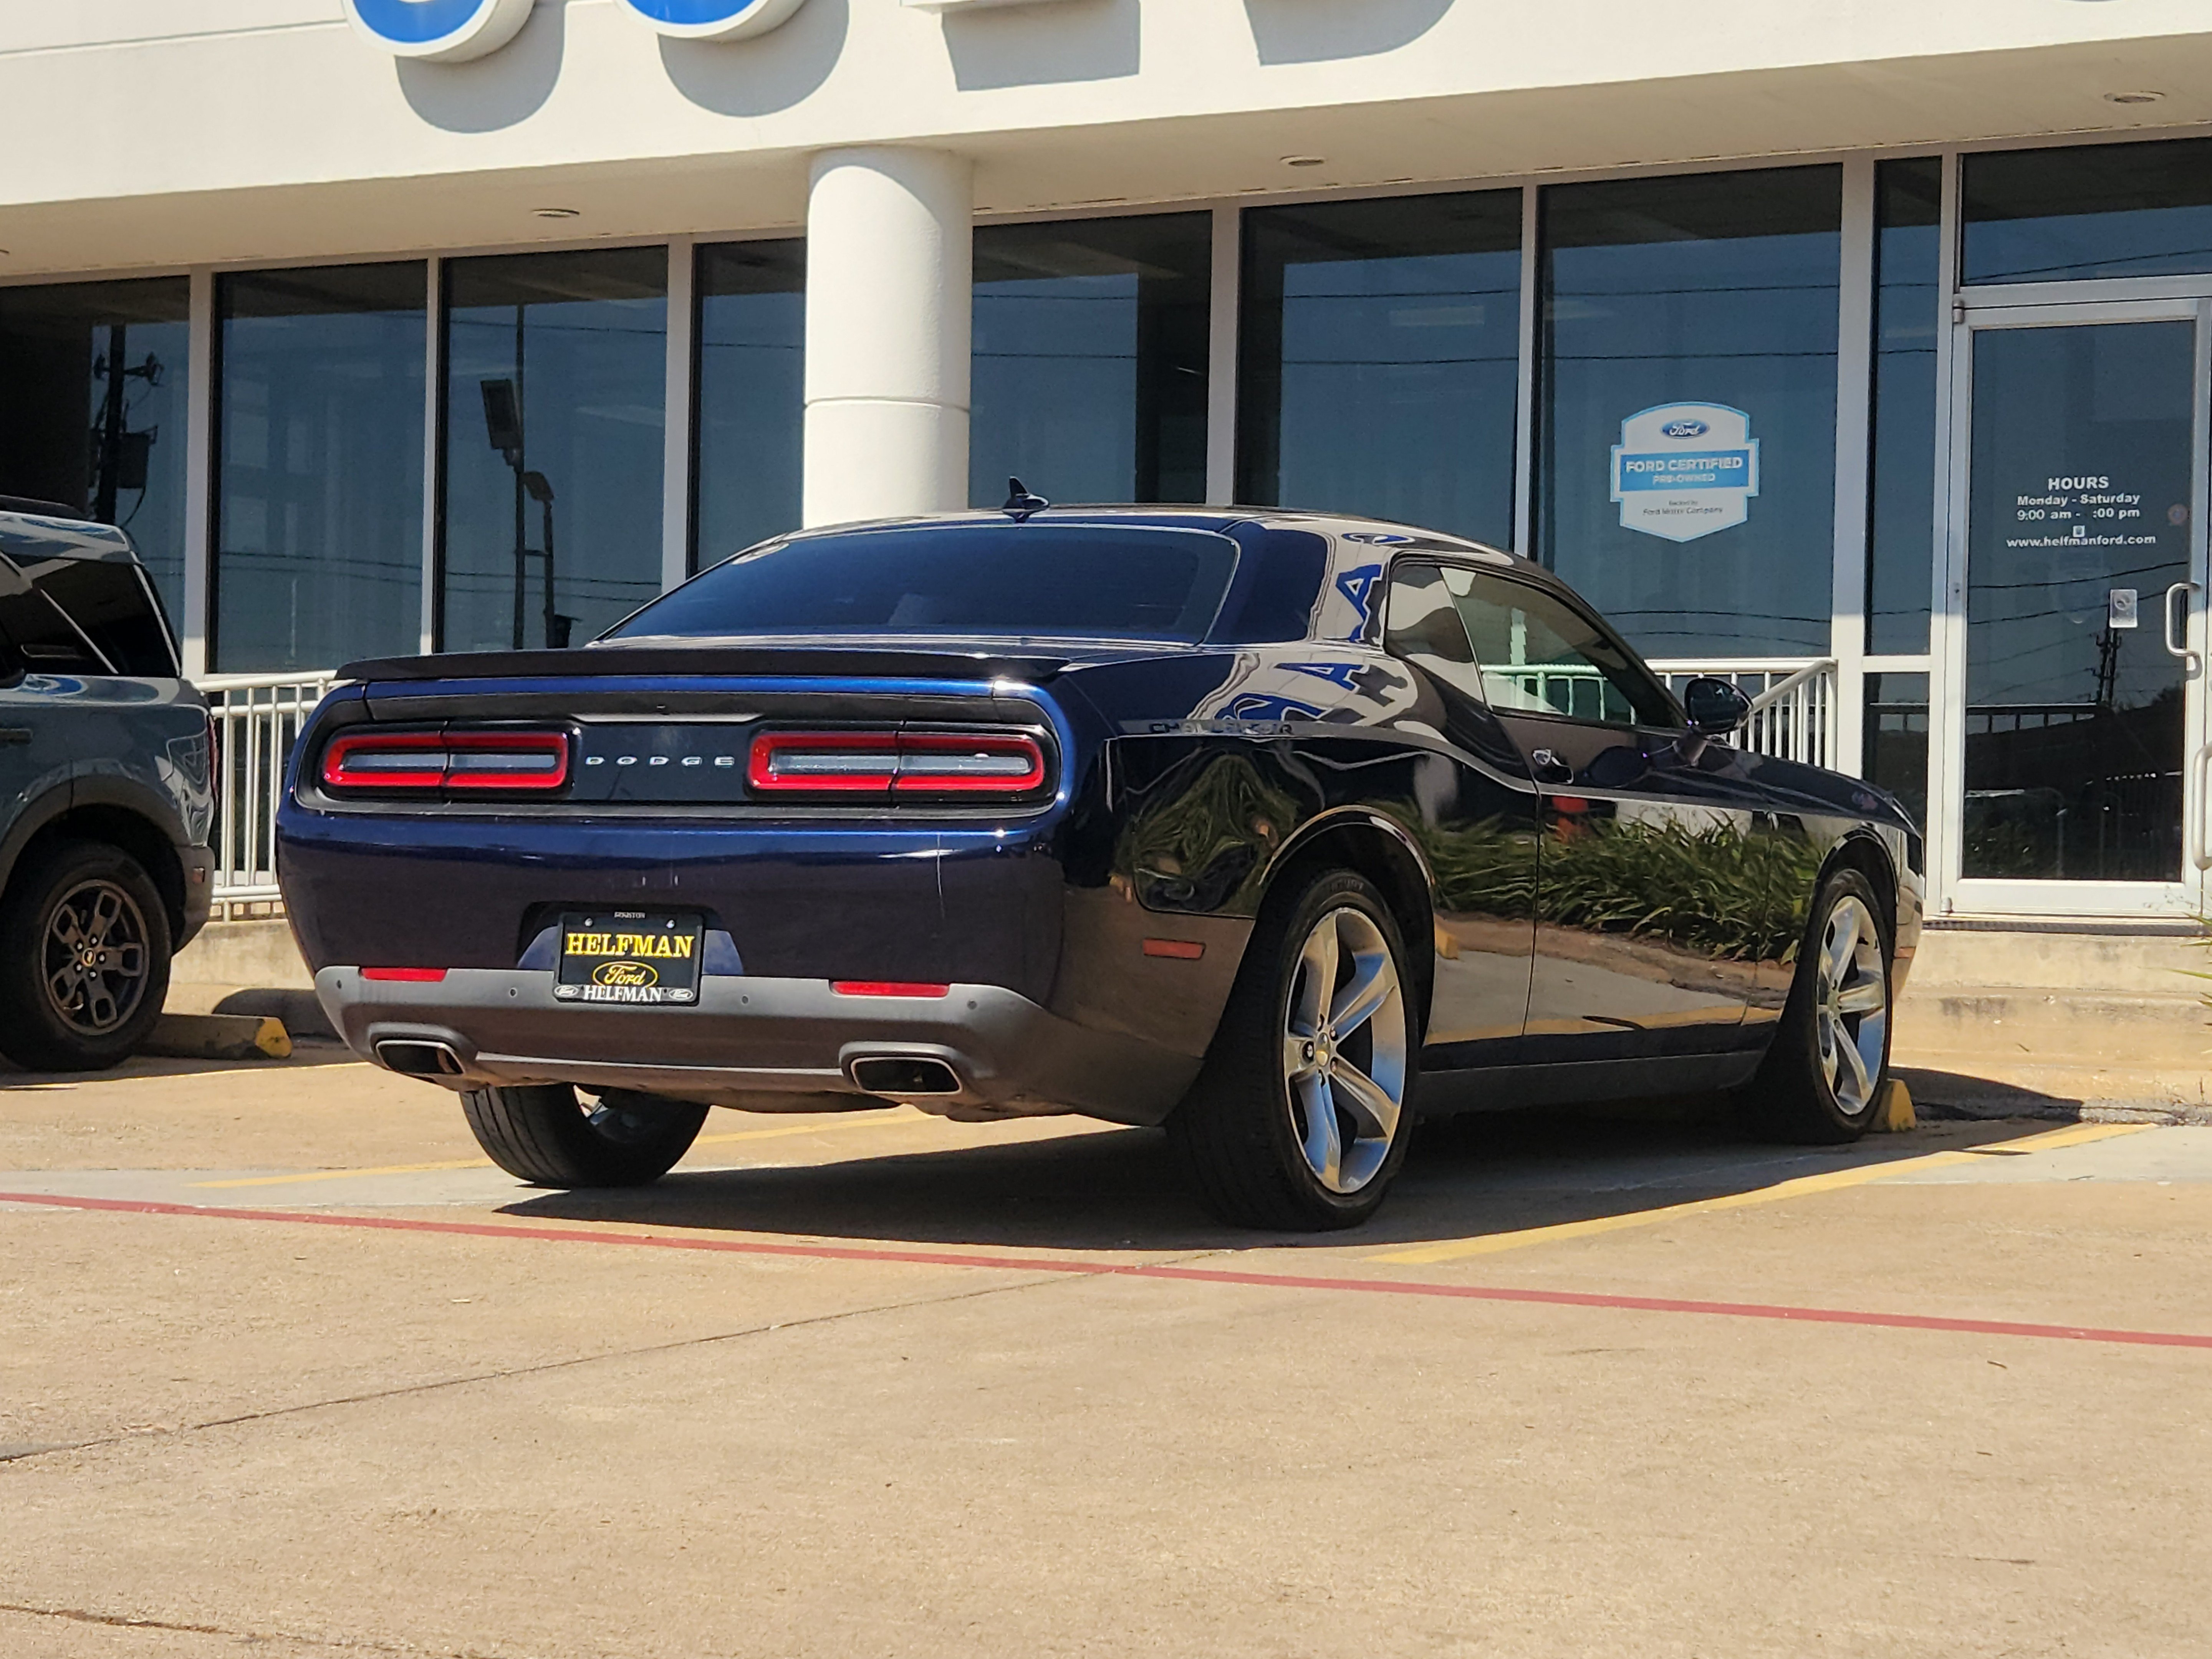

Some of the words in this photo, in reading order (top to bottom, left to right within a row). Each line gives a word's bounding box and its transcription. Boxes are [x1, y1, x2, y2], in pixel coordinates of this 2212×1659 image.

[1669, 422, 1700, 435] Ford
[1626, 460, 1664, 473] FORD
[1668, 457, 1743, 471] CERTIFIED
[1653, 473, 1715, 485] PRE-OWNED
[2048, 476, 2109, 492] HOURS
[2017, 495, 2068, 507] Monday
[2080, 493, 2140, 505] Saturday
[2017, 509, 2045, 521] 9:00
[2050, 511, 2072, 520] am
[2118, 508, 2140, 520] pm
[2006, 534, 2156, 548] www.helfmanford.com
[1149, 722, 1295, 734] CHALLER
[585, 756, 735, 767] DODGE
[565, 933, 695, 958] HELFMAN
[604, 964, 646, 985] Ford
[583, 984, 664, 1001] HELFMAN
